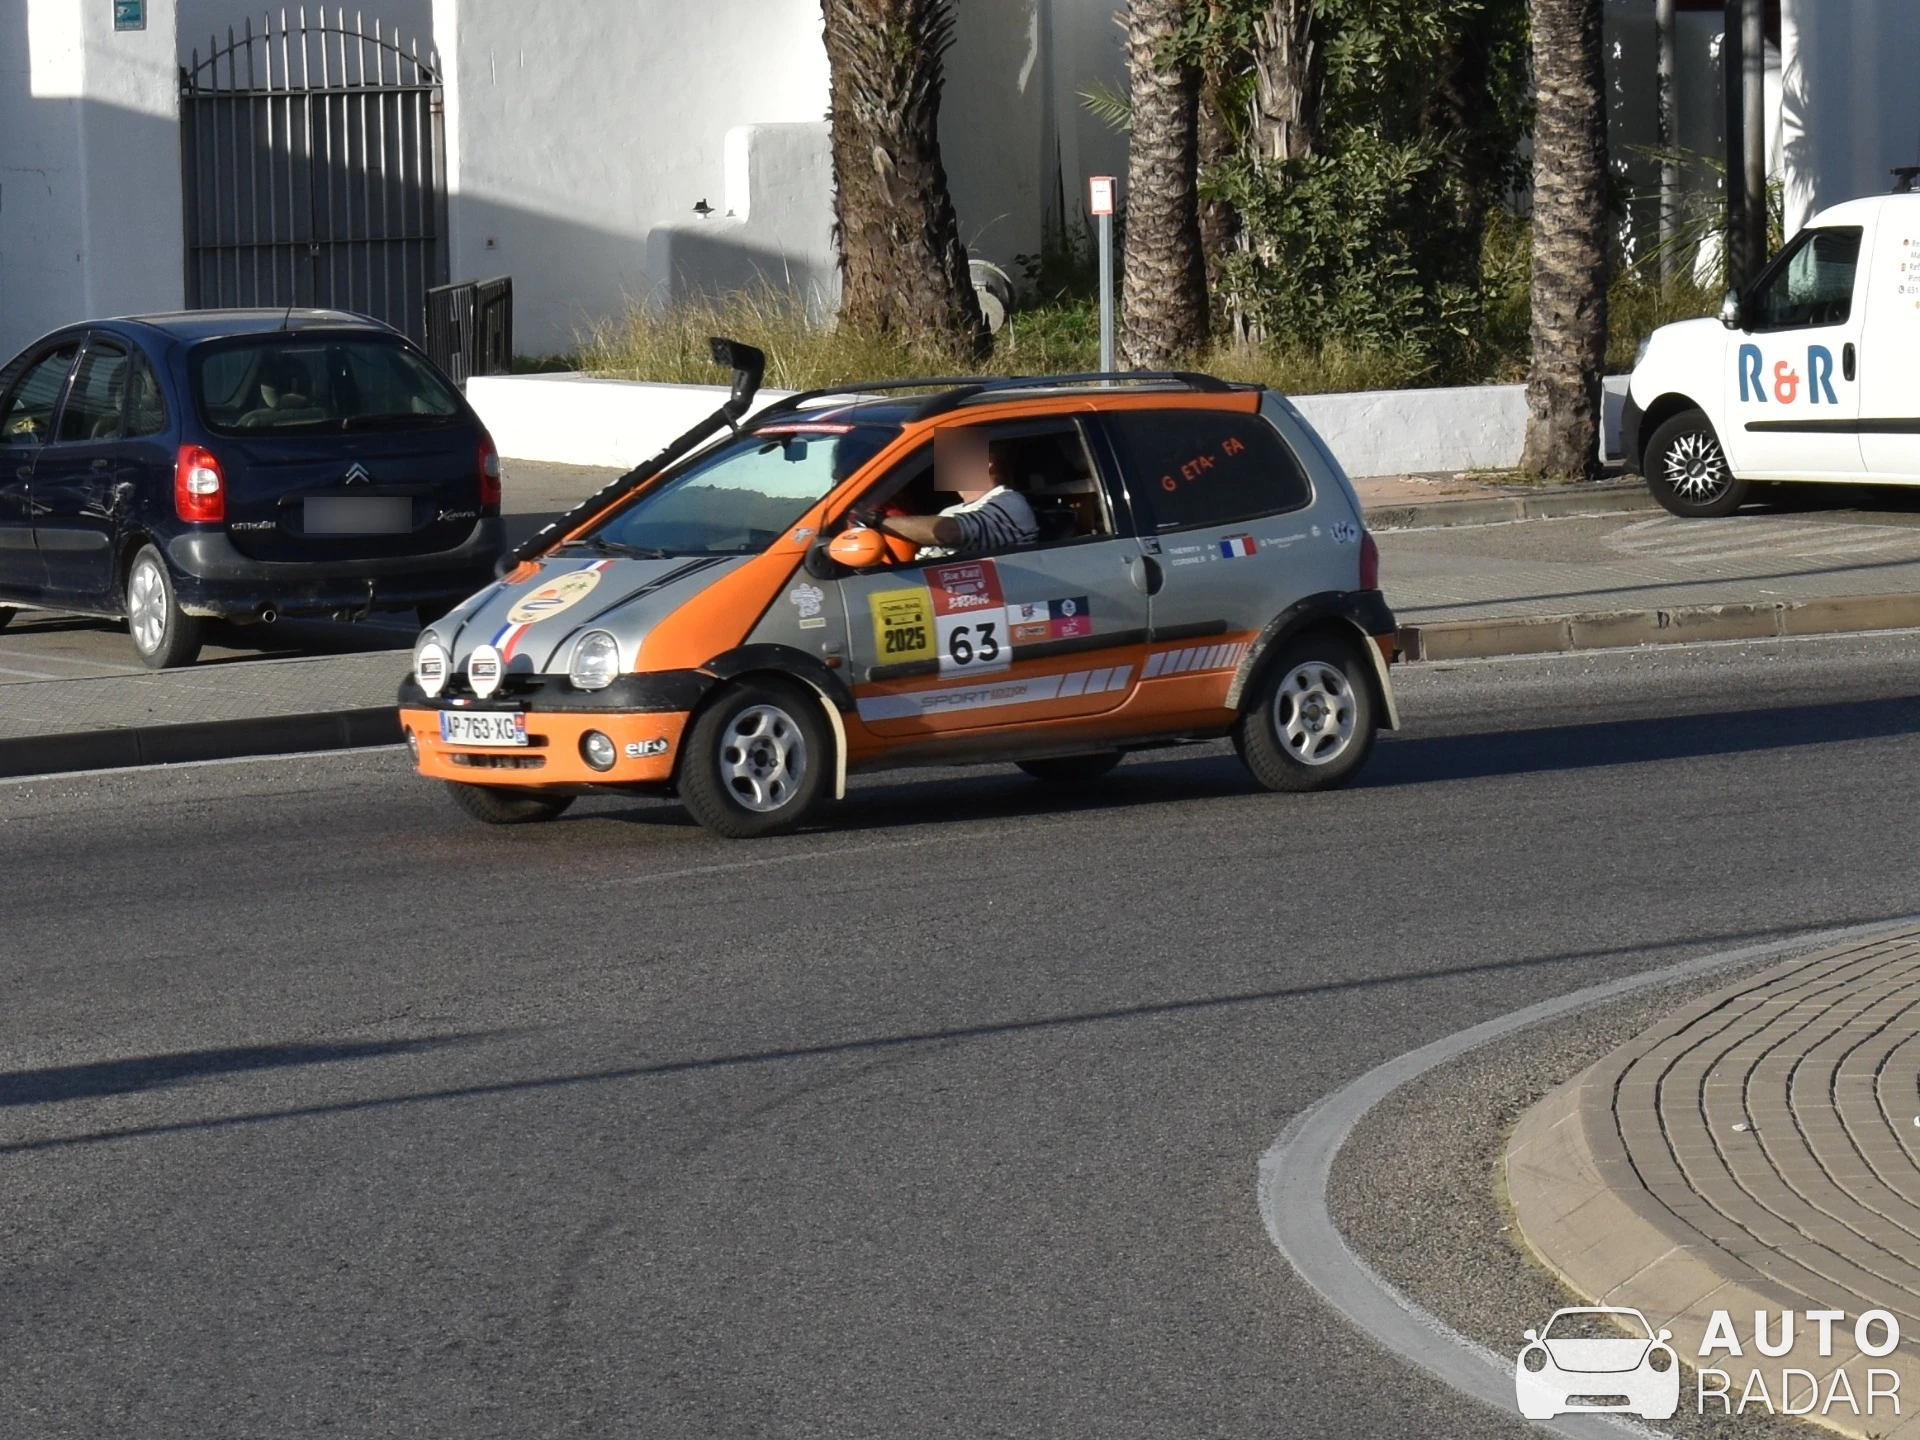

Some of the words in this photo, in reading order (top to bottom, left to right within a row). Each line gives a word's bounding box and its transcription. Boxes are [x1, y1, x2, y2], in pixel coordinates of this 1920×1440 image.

[885, 627, 926, 653] 2025
[949, 622, 999, 665] 63
[920, 690, 990, 708] SPORT
[447, 716, 514, 739] AP-763-XG
[625, 740, 653, 754] elf
